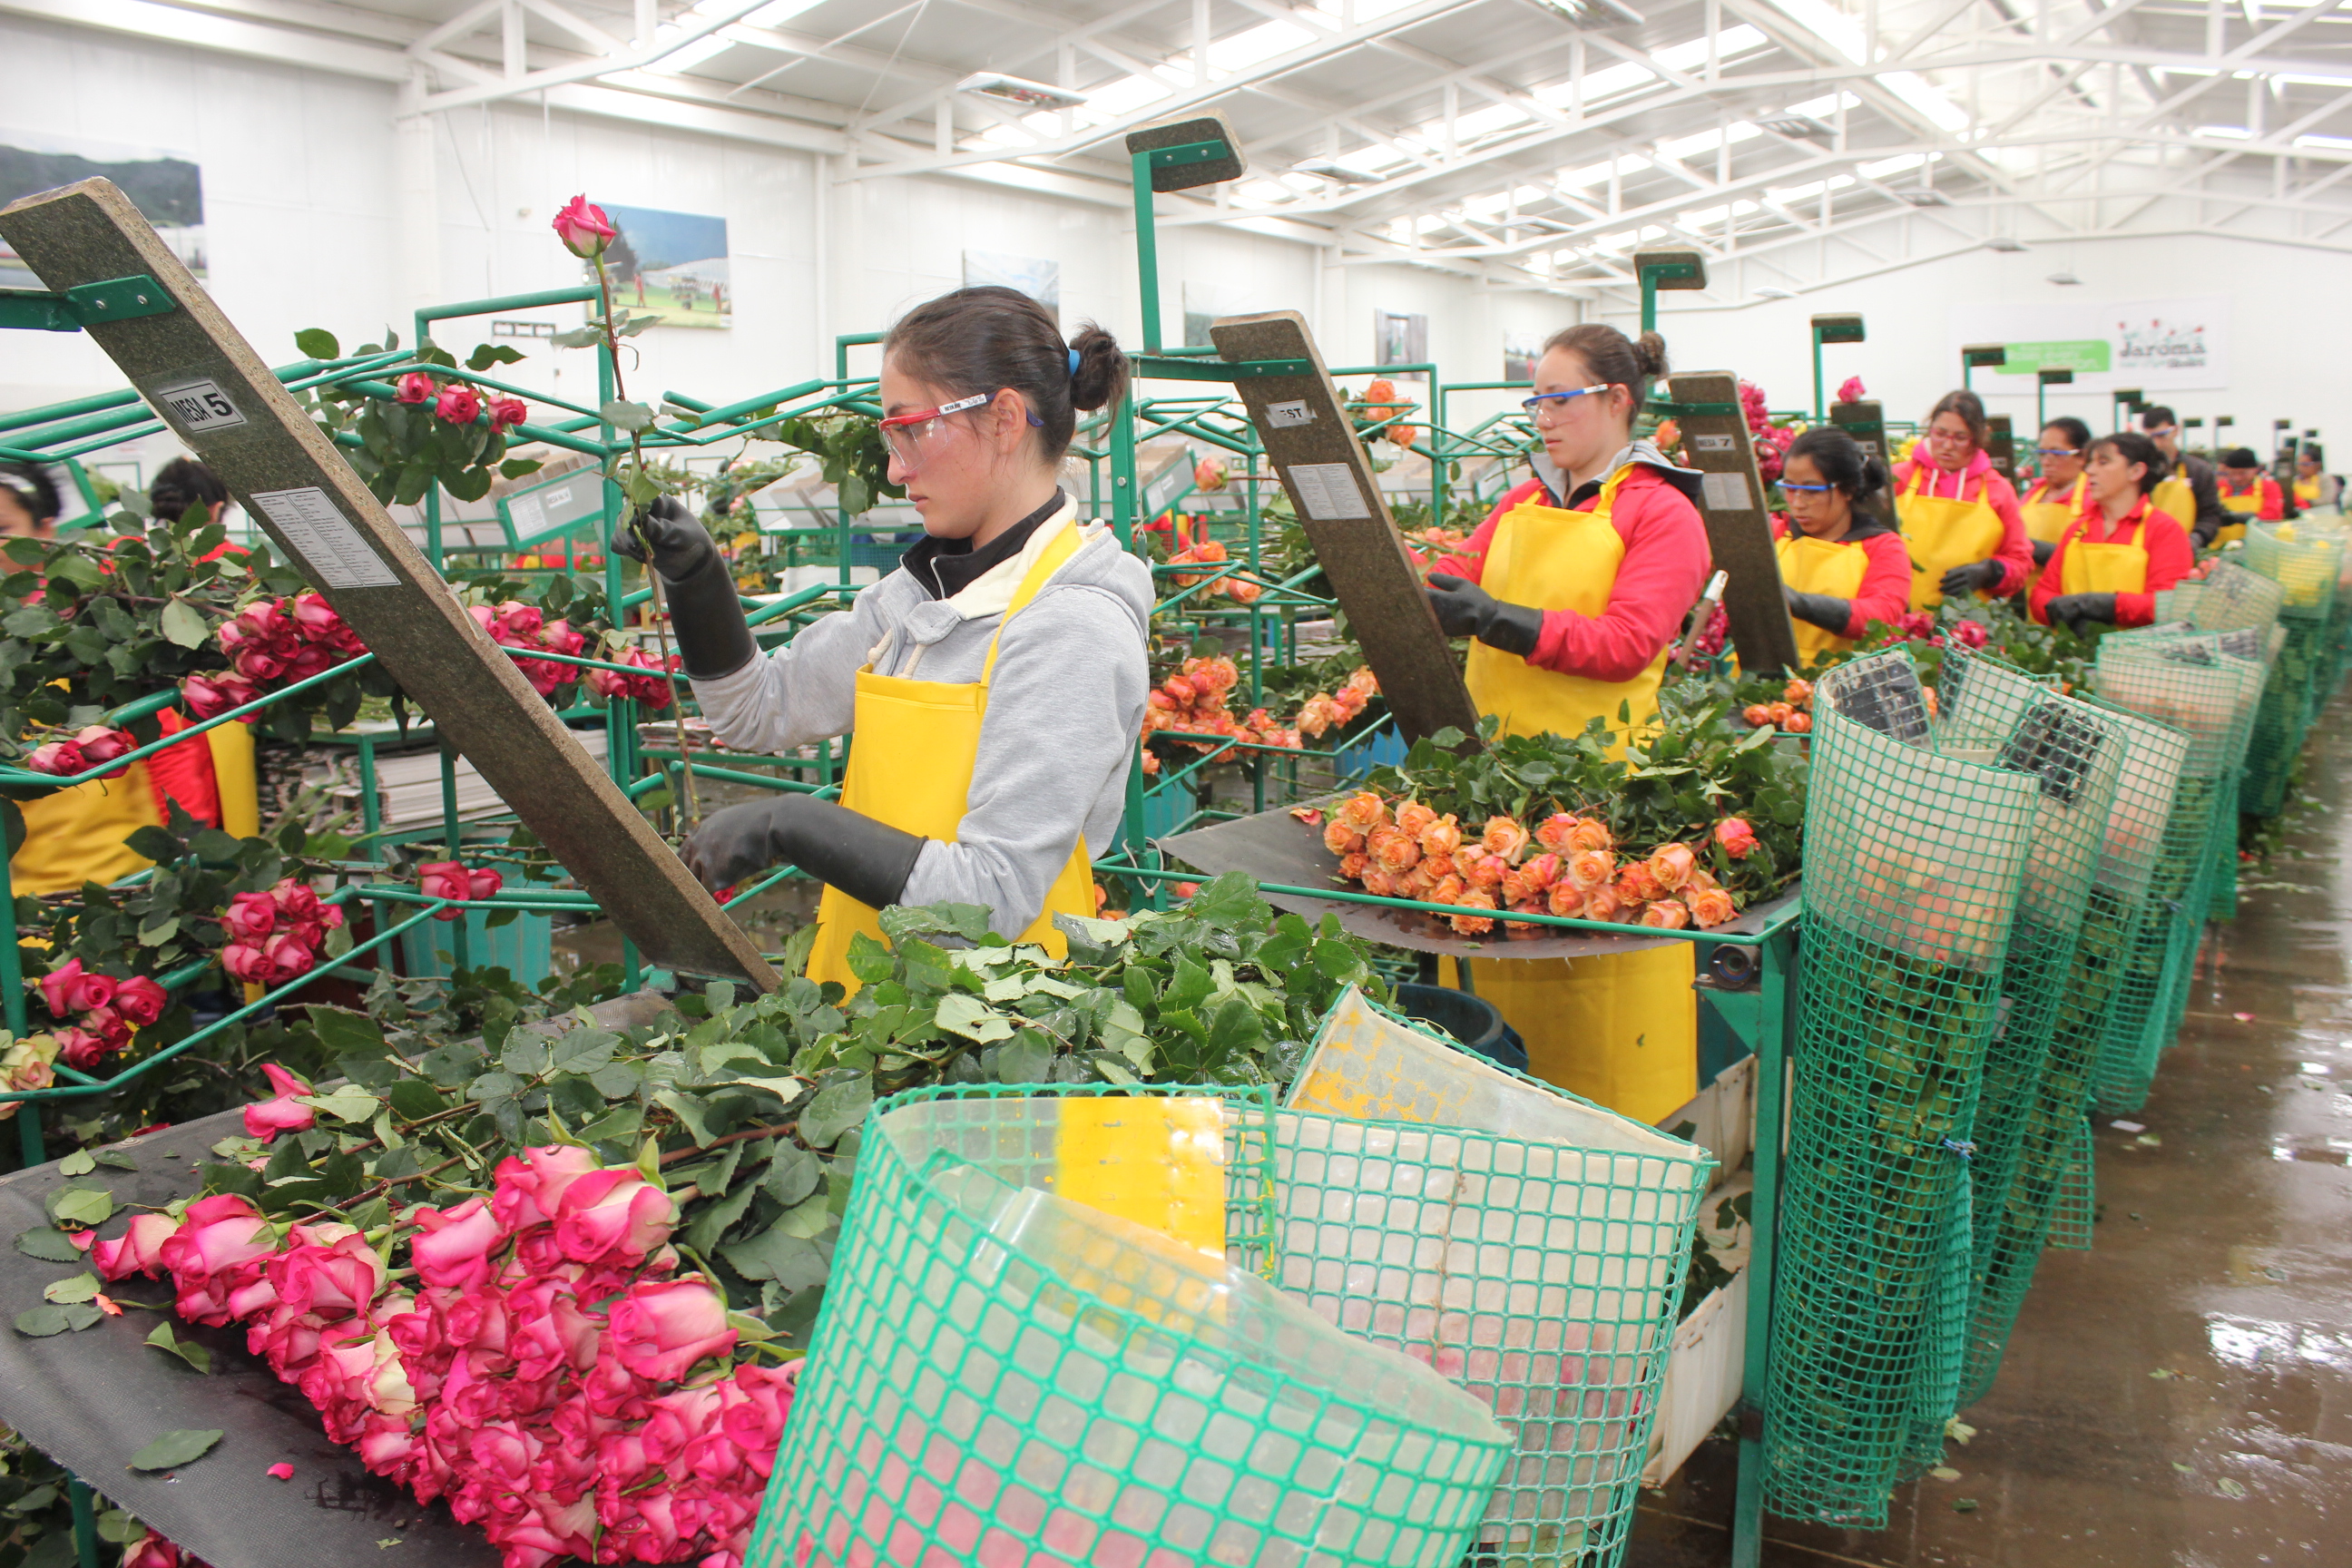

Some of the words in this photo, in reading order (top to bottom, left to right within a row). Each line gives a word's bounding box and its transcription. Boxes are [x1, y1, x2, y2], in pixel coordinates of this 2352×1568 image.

[170, 397, 212, 424] MESA
[202, 392, 233, 417] 5
[1719, 438, 1730, 446] 7
